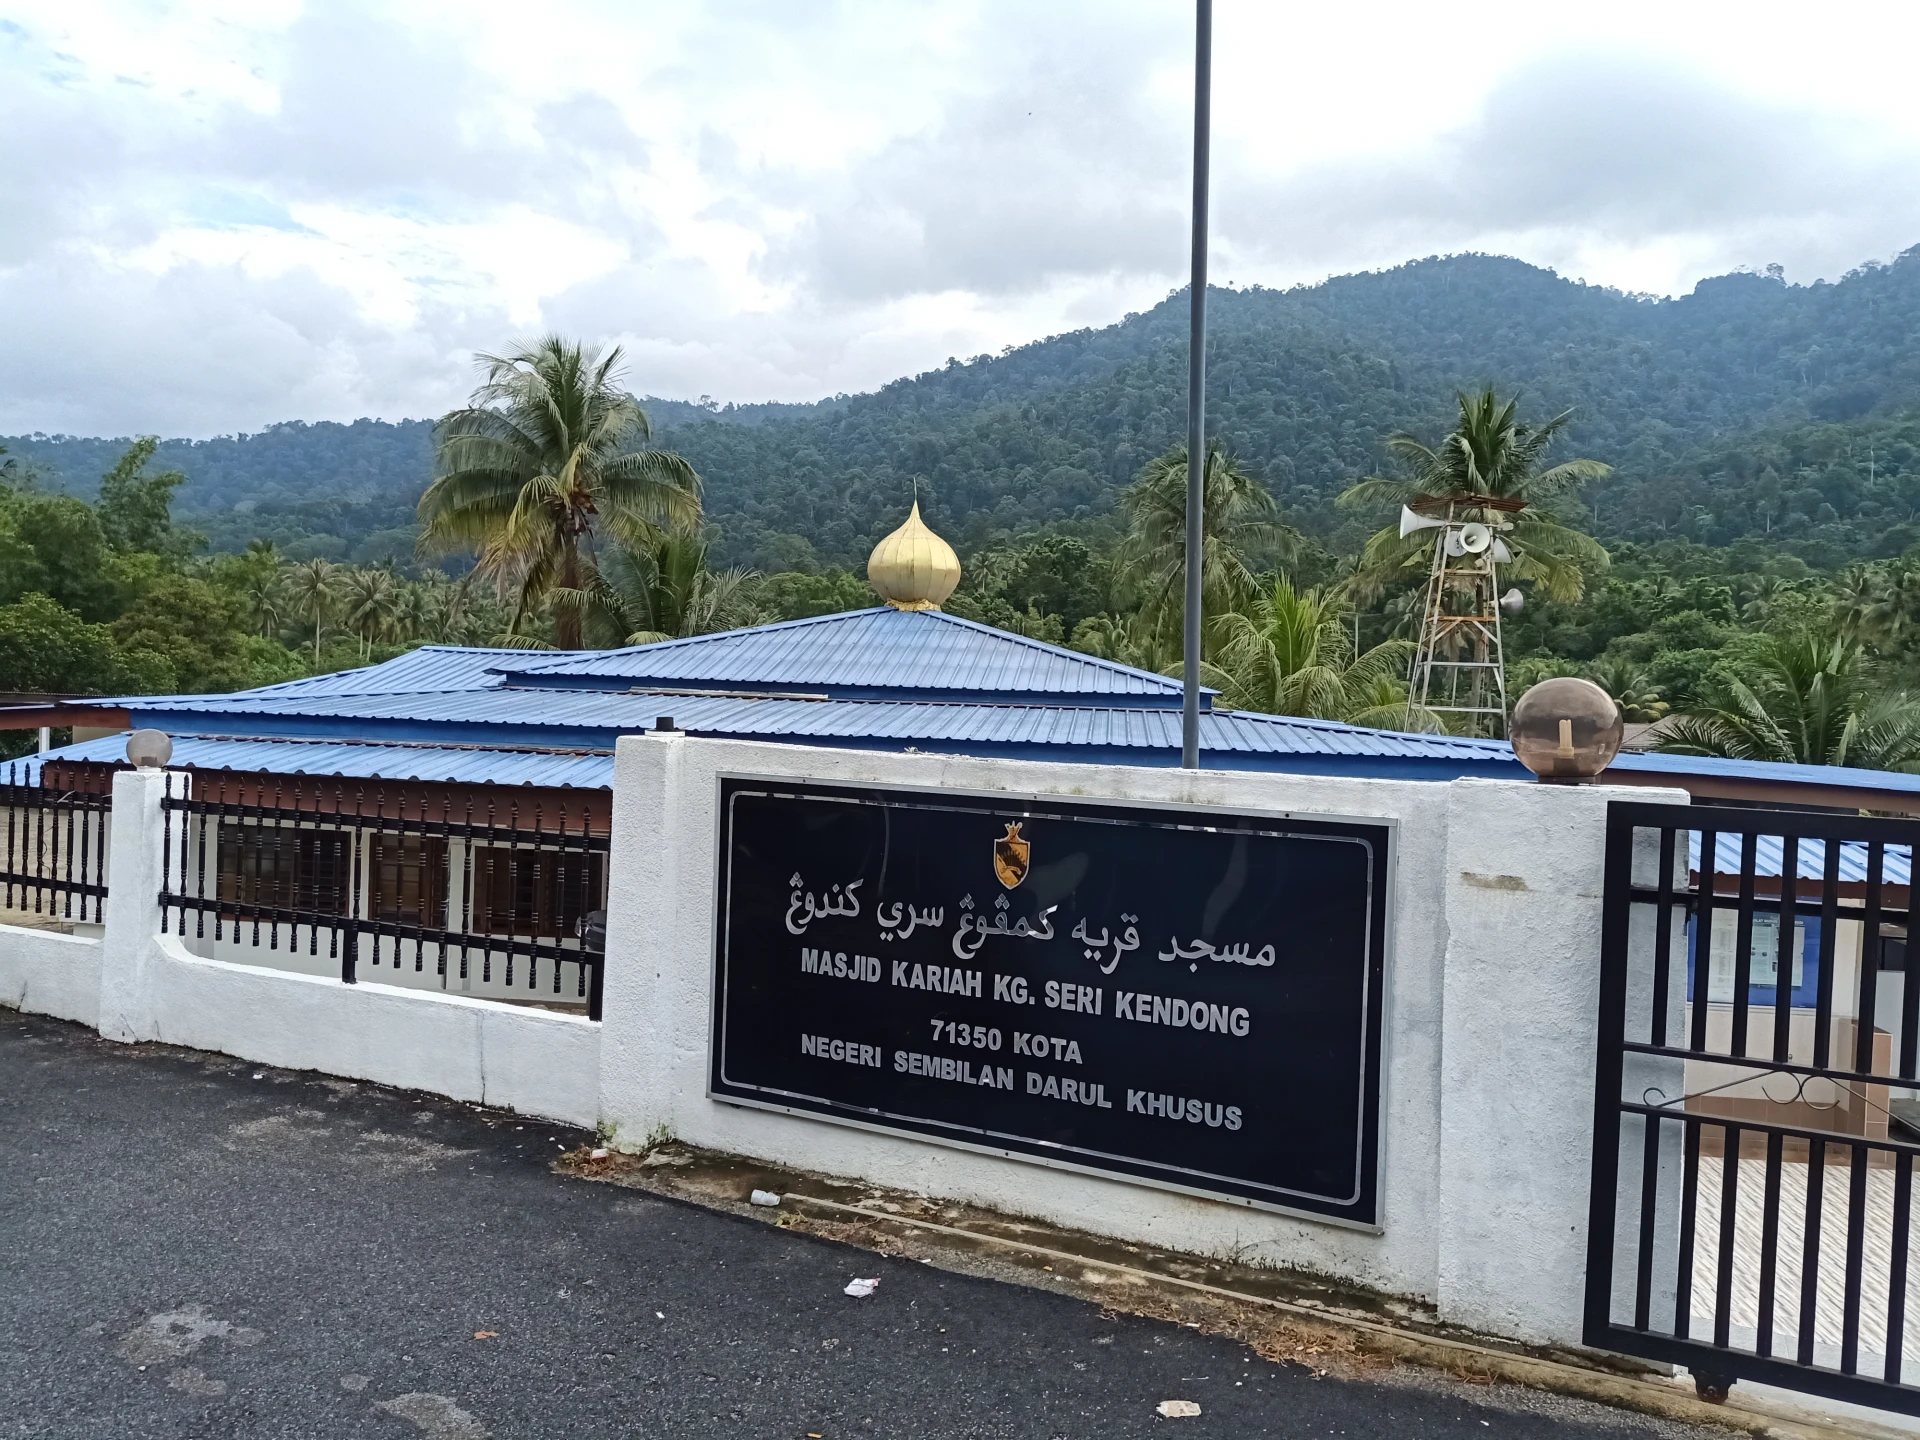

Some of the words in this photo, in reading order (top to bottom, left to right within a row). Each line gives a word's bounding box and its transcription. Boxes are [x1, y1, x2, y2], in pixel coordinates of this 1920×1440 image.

[877, 902, 944, 942] سري
[1158, 935, 1276, 973] مسجد
[801, 947, 882, 983] MASJID
[891, 959, 982, 998] KARIAH
[993, 973, 1036, 1005] KG.
[1044, 980, 1103, 1016] SERI
[1115, 990, 1250, 1037] KENDONG
[930, 1018, 1002, 1051] 71350
[1013, 1031, 1083, 1065] KOTA
[801, 1033, 882, 1068] NEGERI
[893, 1050, 1014, 1091] SEMBILAN
[1026, 1071, 1112, 1109] DARUL
[1126, 1088, 1243, 1131] KHUSUS
